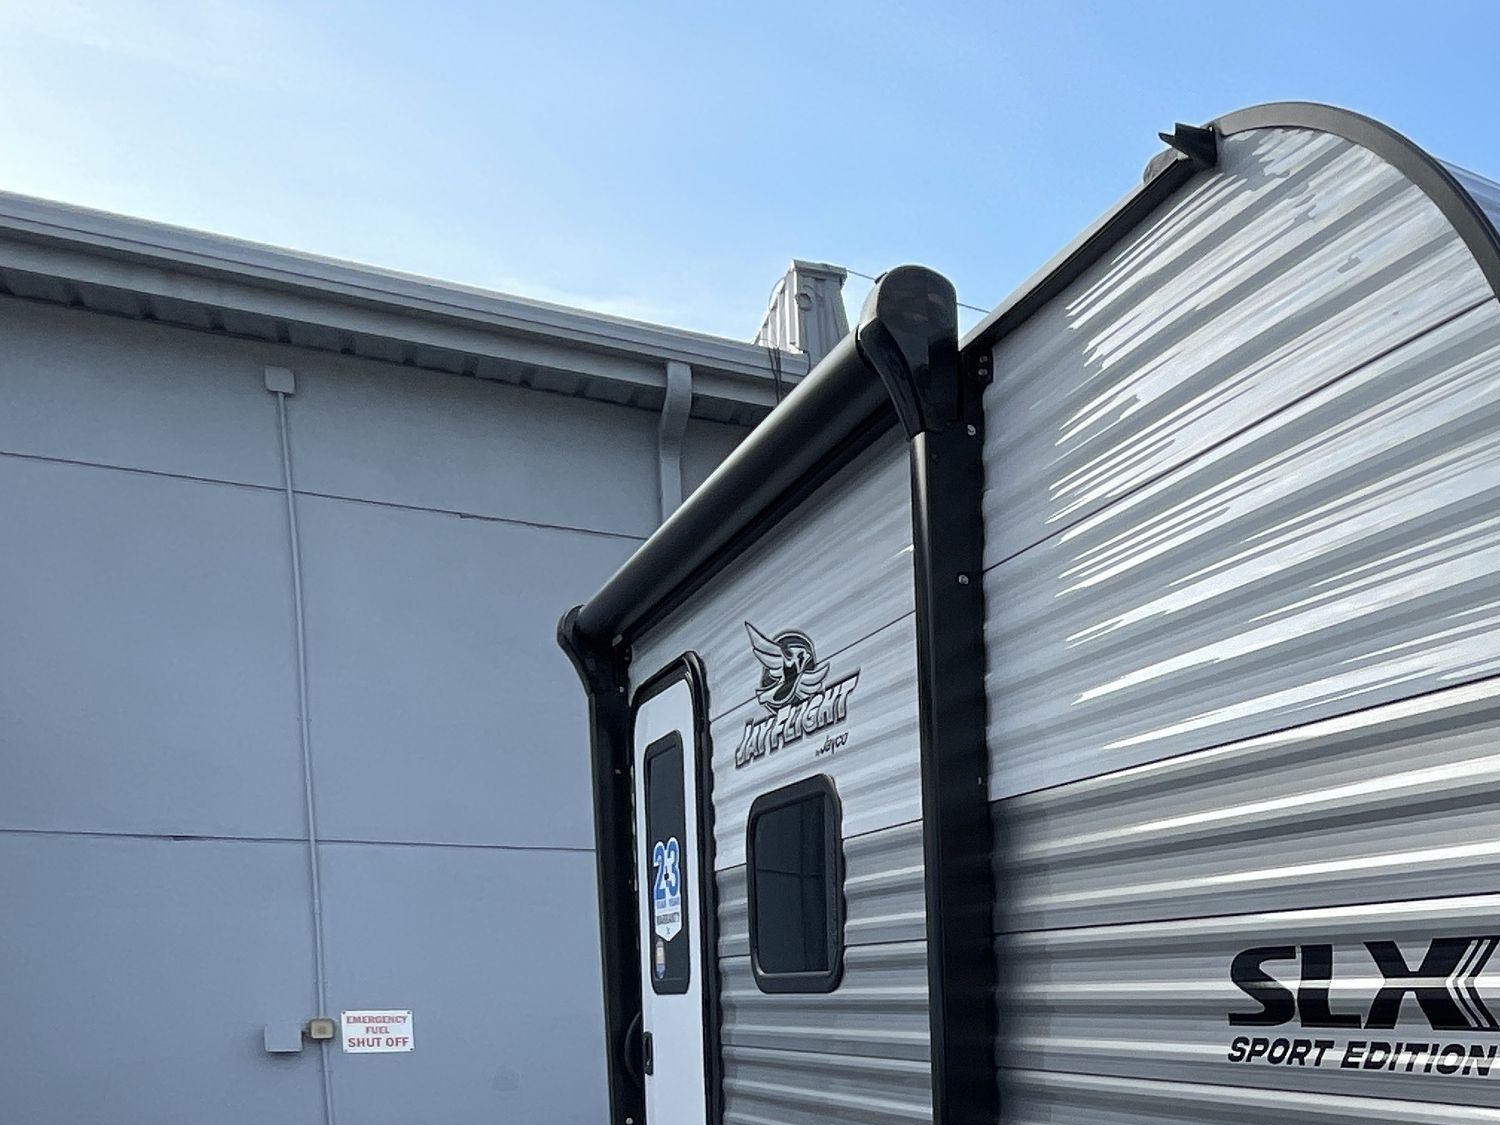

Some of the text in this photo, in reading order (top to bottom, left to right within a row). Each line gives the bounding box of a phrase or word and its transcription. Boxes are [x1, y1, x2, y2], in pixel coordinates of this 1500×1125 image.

[346, 1015, 408, 1024] EMERGENCY
[365, 1026, 390, 1034] FUEL
[348, 1037, 409, 1047] SHUT OFF
[1228, 1036, 1498, 1076] SPORT EDITION
